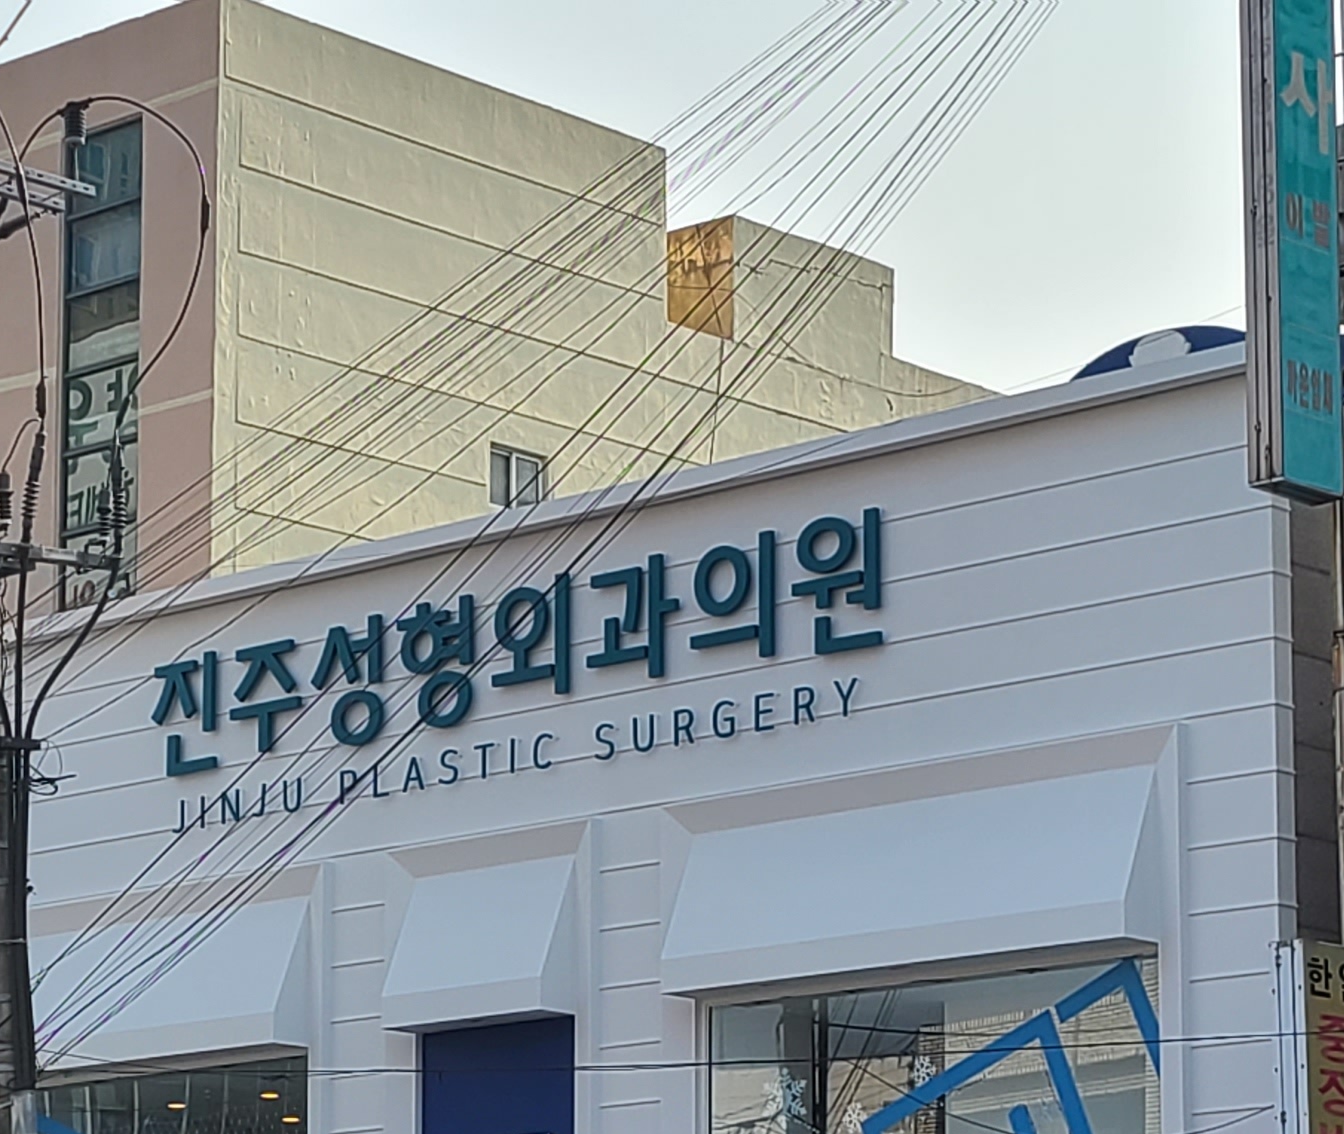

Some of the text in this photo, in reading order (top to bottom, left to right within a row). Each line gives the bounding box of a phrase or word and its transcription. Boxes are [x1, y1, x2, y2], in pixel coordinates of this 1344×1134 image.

[150, 506, 885, 778] 진주성형외과의원
[172, 677, 861, 834] JINJU PLASTIC SURGERY
